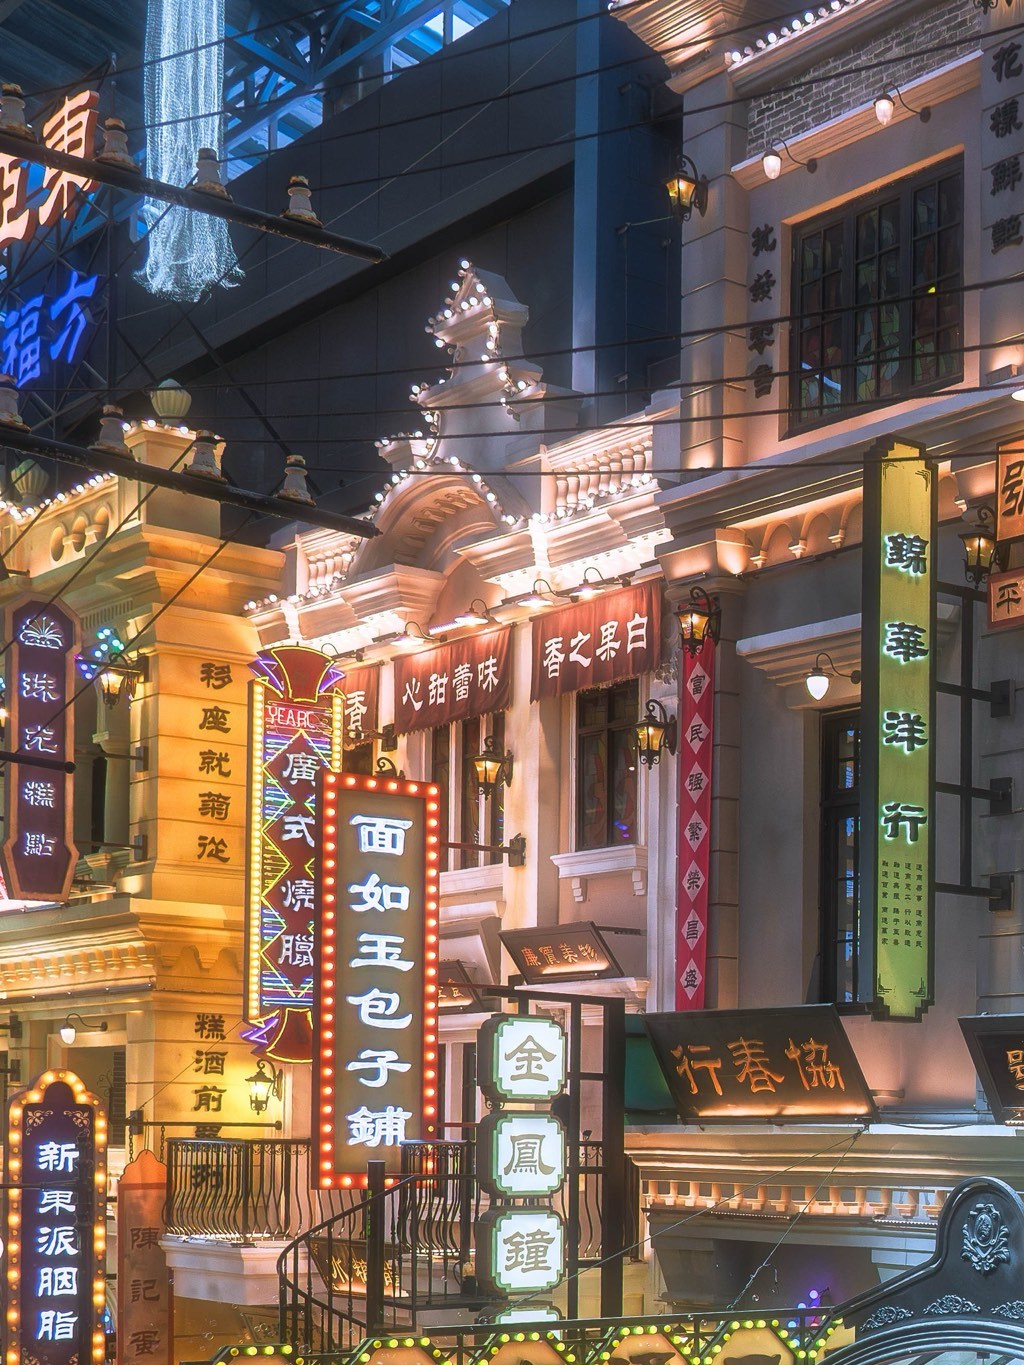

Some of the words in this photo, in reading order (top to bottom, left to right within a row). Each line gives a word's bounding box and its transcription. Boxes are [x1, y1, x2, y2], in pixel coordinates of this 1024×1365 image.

[346, 813, 414, 1148] 面如玉包子鋪
